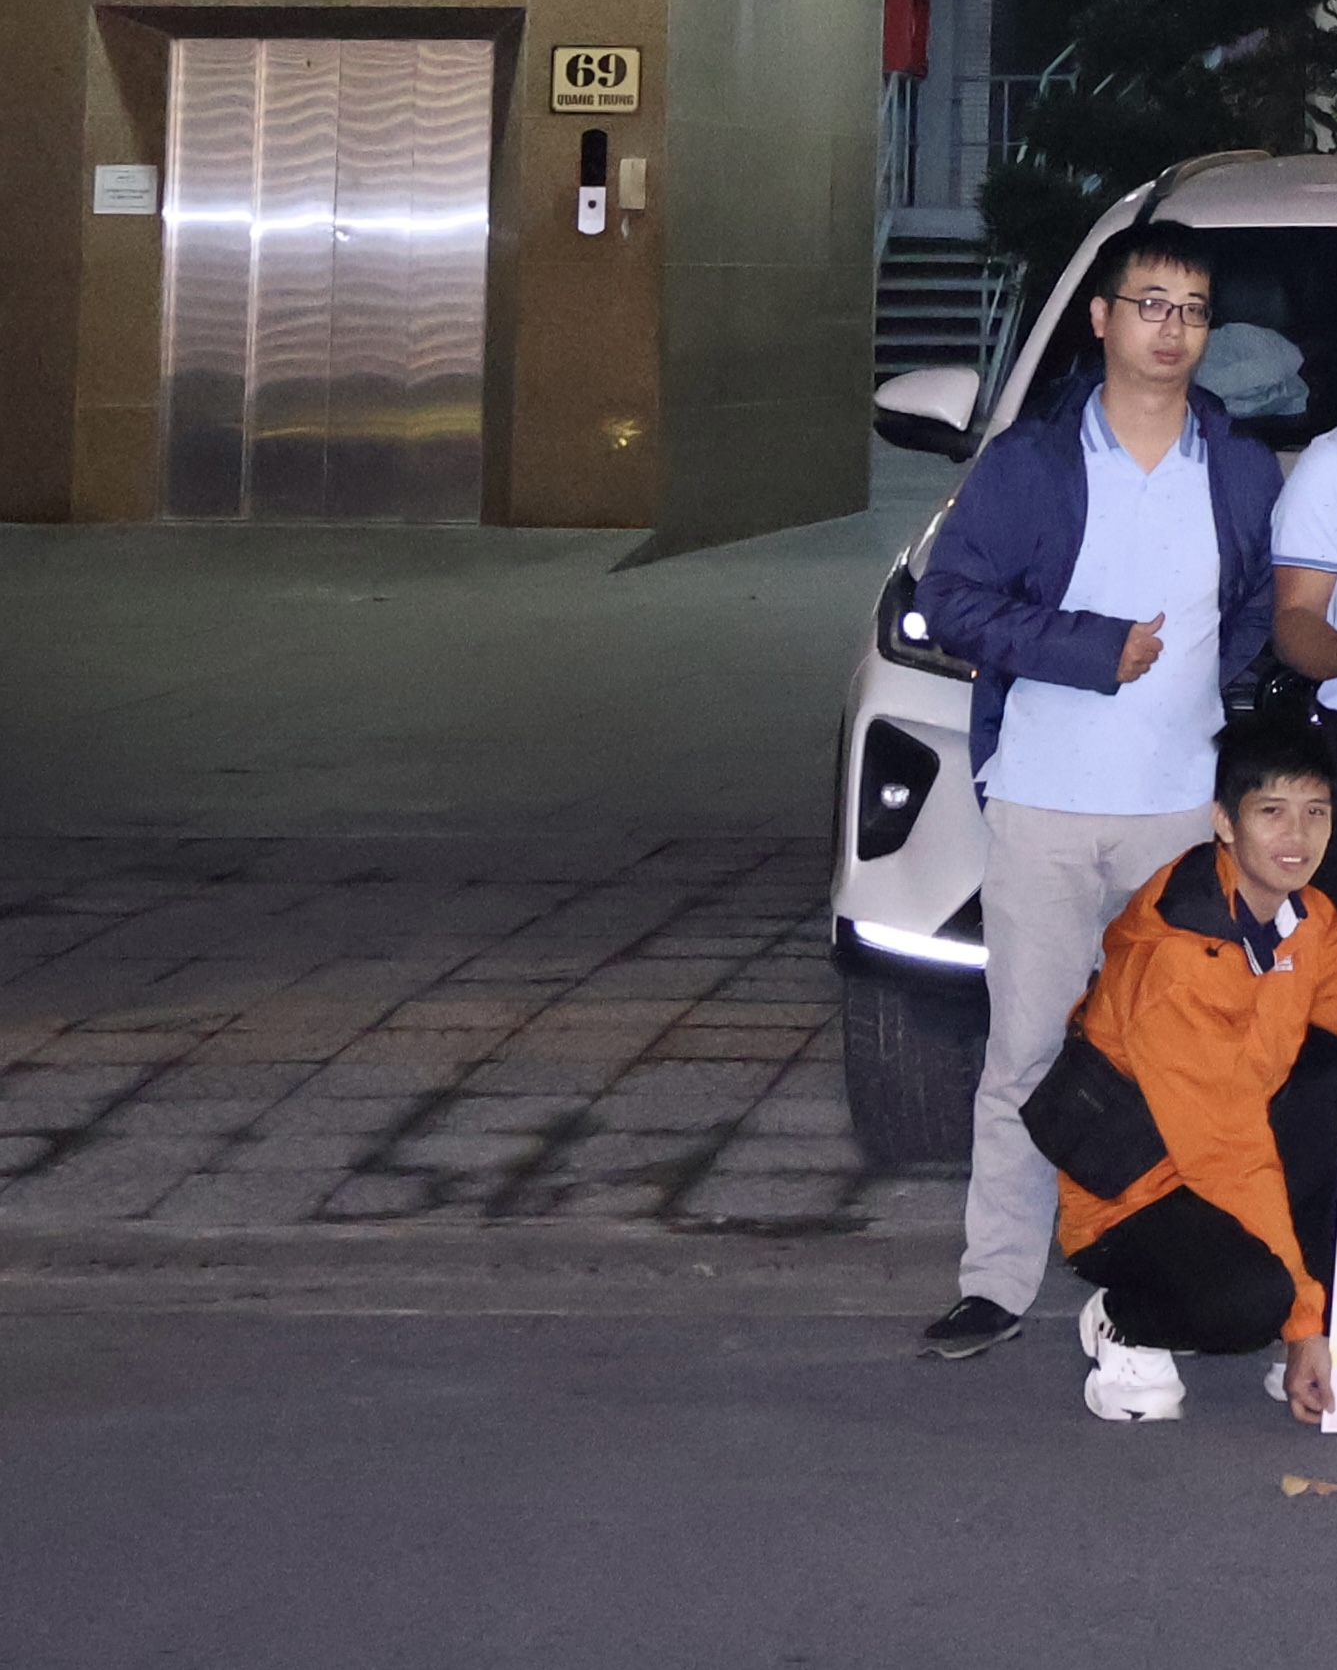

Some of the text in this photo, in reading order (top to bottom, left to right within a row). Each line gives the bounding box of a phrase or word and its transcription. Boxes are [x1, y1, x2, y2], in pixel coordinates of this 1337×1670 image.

[565, 53, 627, 88] 69
[557, 94, 634, 106] QUANG TRUNG
